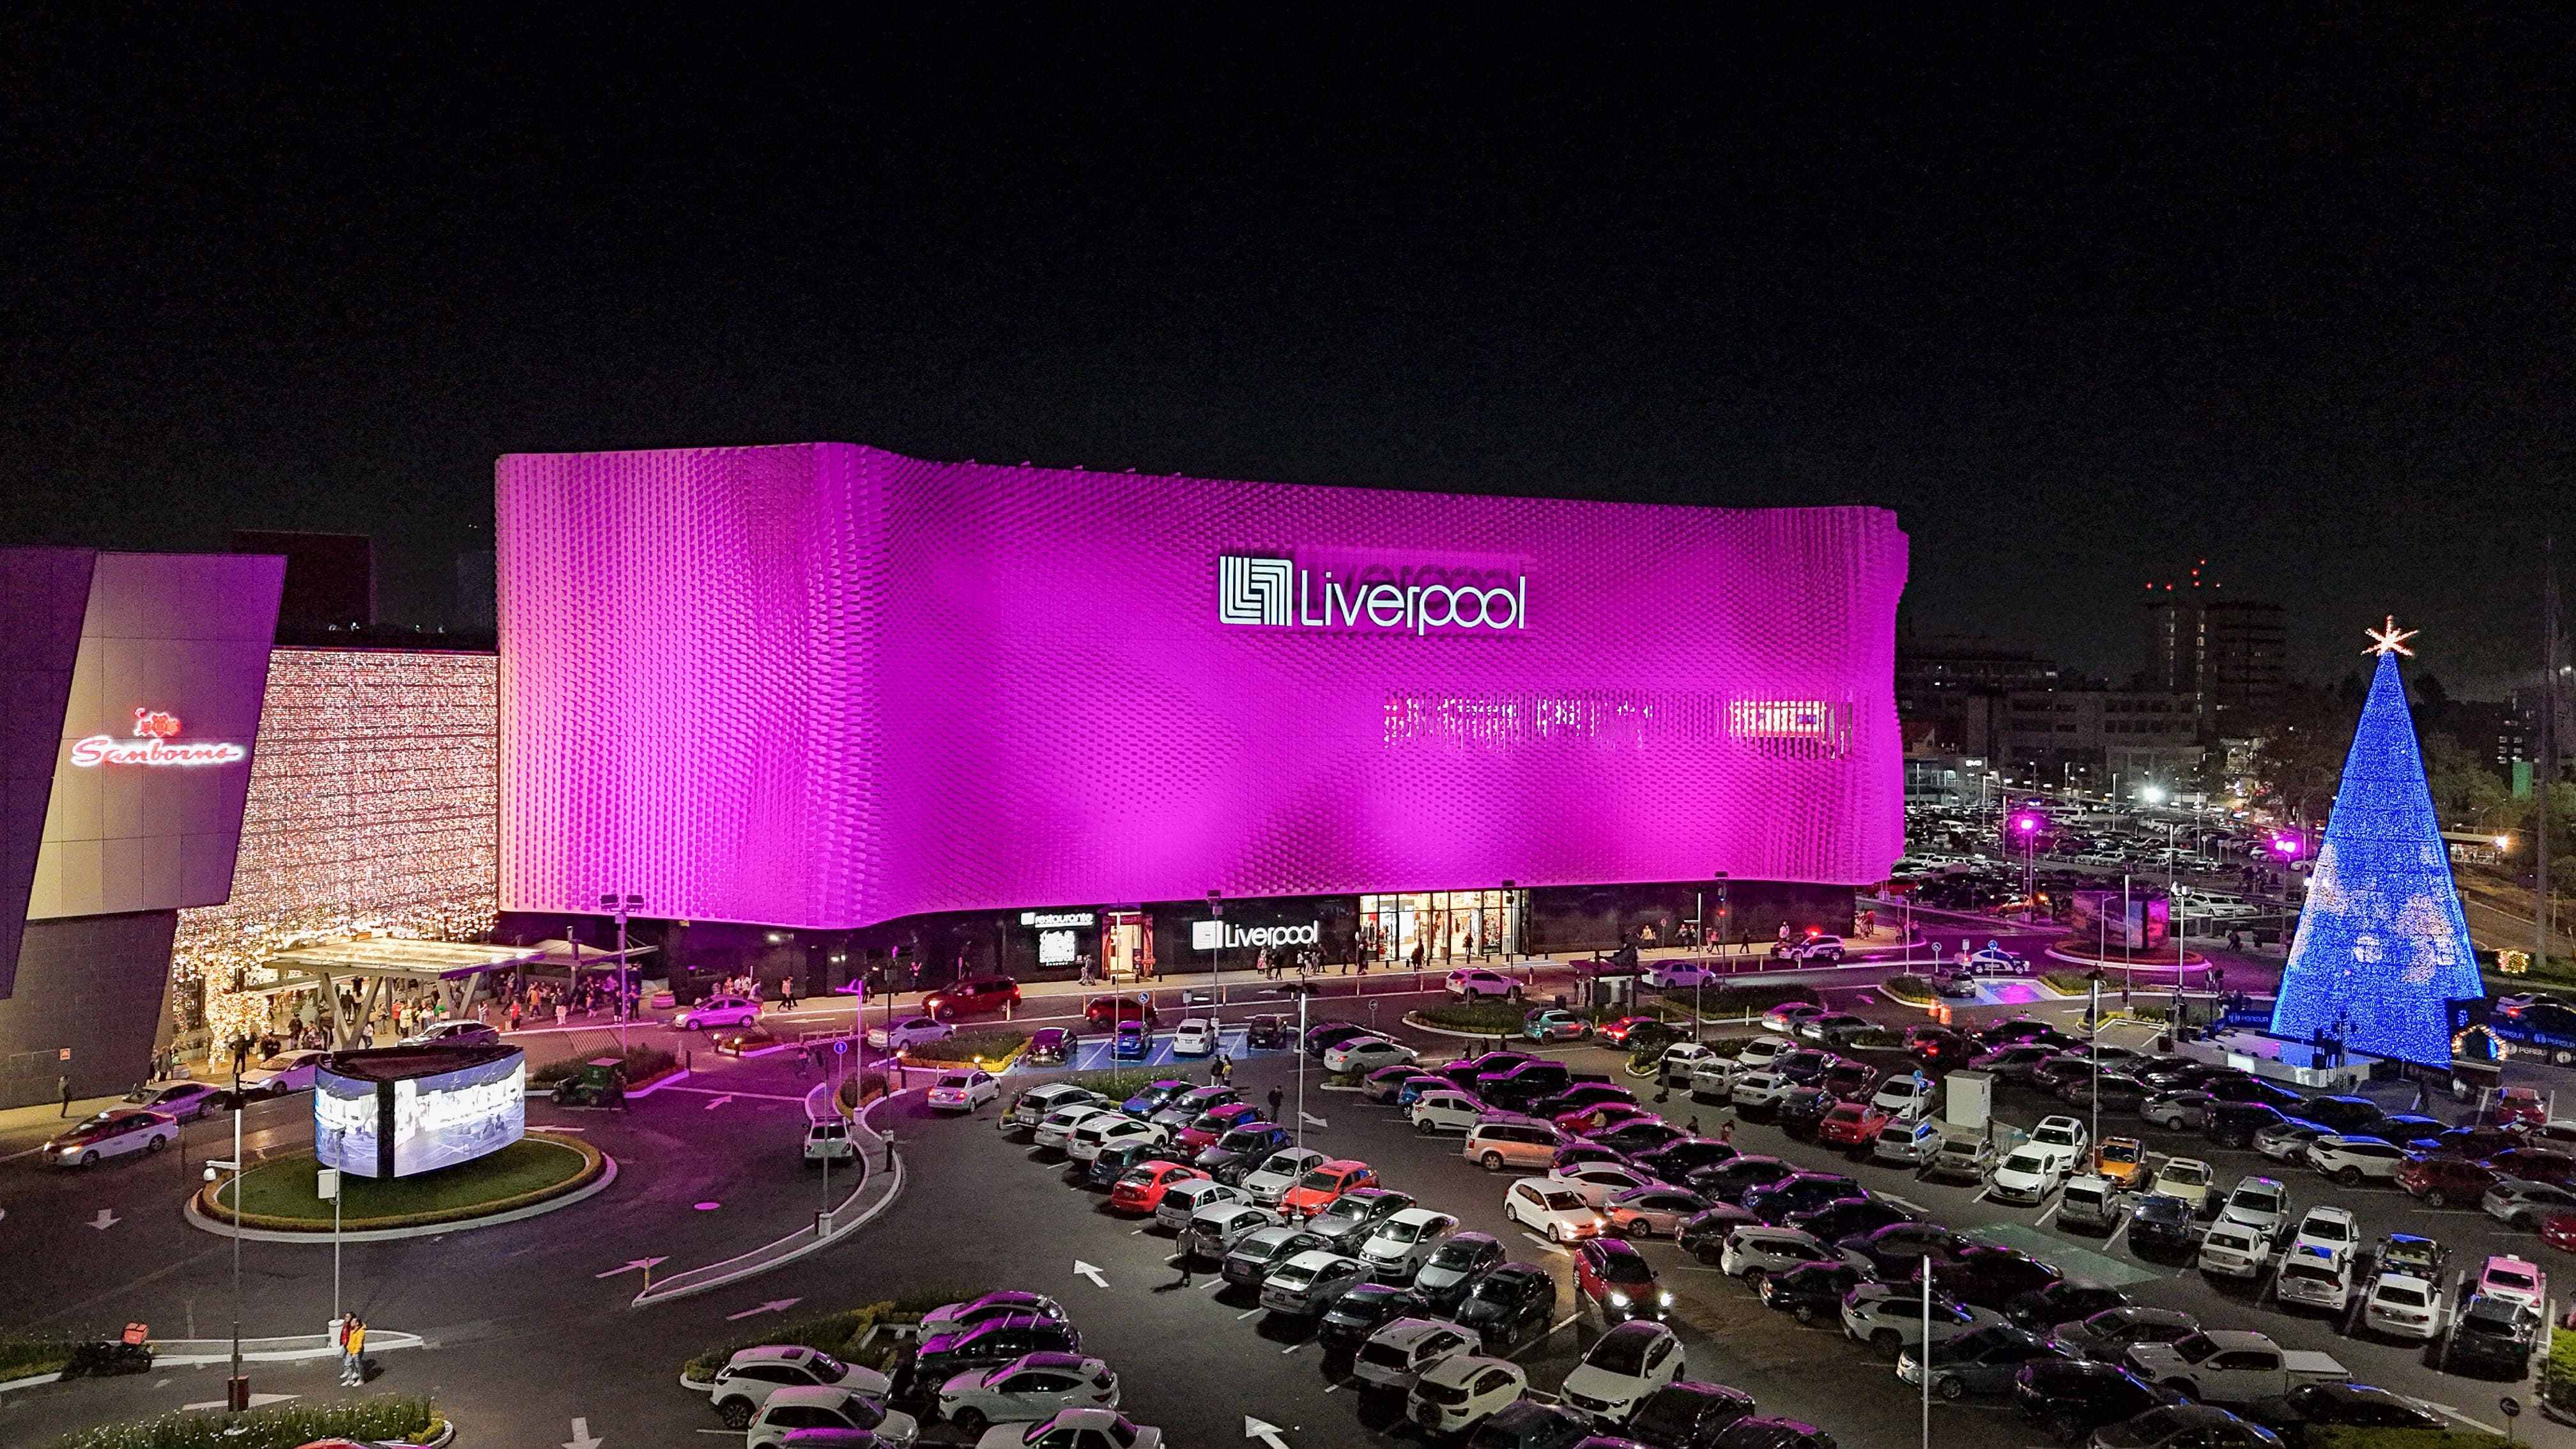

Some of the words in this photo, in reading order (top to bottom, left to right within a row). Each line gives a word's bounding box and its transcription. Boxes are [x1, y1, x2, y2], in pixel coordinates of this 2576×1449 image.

[1301, 569, 1526, 636] Liverpool
[72, 737, 243, 765] Sanborns
[1225, 920, 1319, 949] Liverpool
